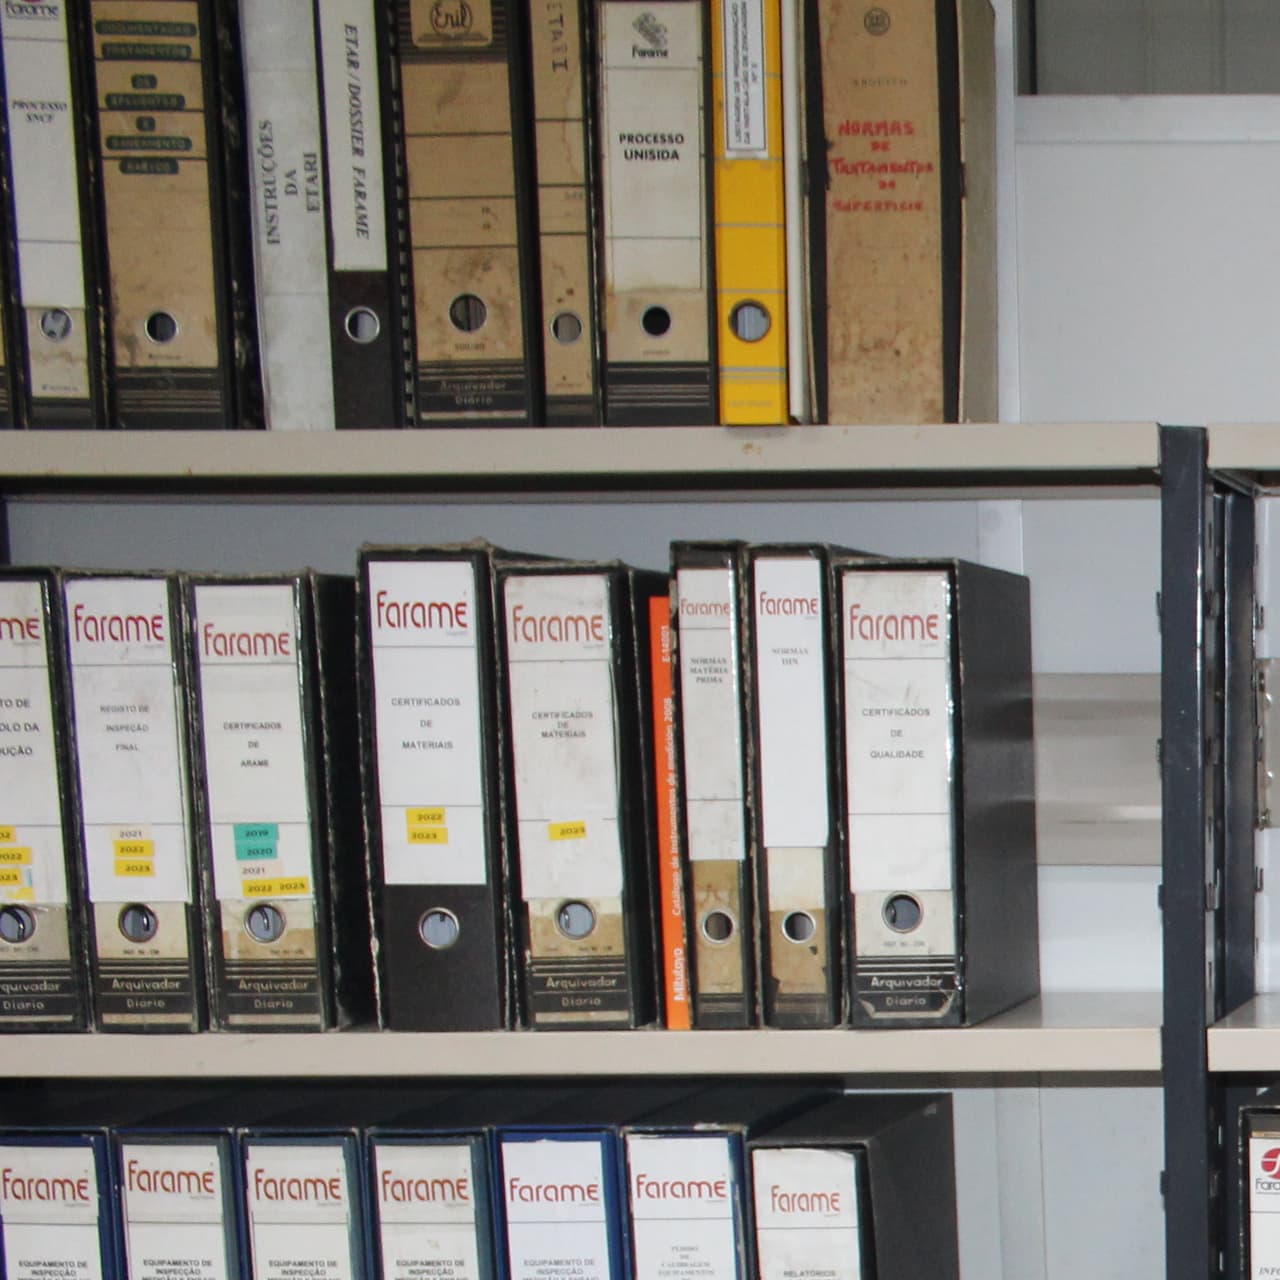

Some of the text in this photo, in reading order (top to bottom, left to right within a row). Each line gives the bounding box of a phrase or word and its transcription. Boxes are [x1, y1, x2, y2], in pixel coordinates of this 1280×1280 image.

[838, 120, 915, 136] NORMAS
[619, 134, 685, 145] PROCESSO
[624, 149, 680, 161] UNISIDA
[258, 120, 280, 245] INSTRUÇÕES
[284, 169, 299, 196] DA
[353, 166, 369, 239] FARAME
[391, 697, 461, 707] CERTIFICADOS
[861, 707, 931, 717] CERTIFICADOS
[223, 722, 282, 730] CERTIFICADOS
[420, 719, 433, 728] DE
[890, 729, 903, 738] DE
[247, 740, 260, 749] DE
[401, 740, 453, 750] MATERIAIS
[870, 749, 924, 759] QUALIDADE
[240, 759, 269, 767] ARAME
[245, 829, 269, 838] 2019
[247, 847, 273, 857] 2020
[242, 866, 266, 875] 2021
[111, 977, 180, 993] Arquivador
[870, 975, 944, 989] Arquivador
[18, 1260, 88, 1268] EQUIPAMENTO DE
[783, 1269, 837, 1279] RELATÓRIOS
